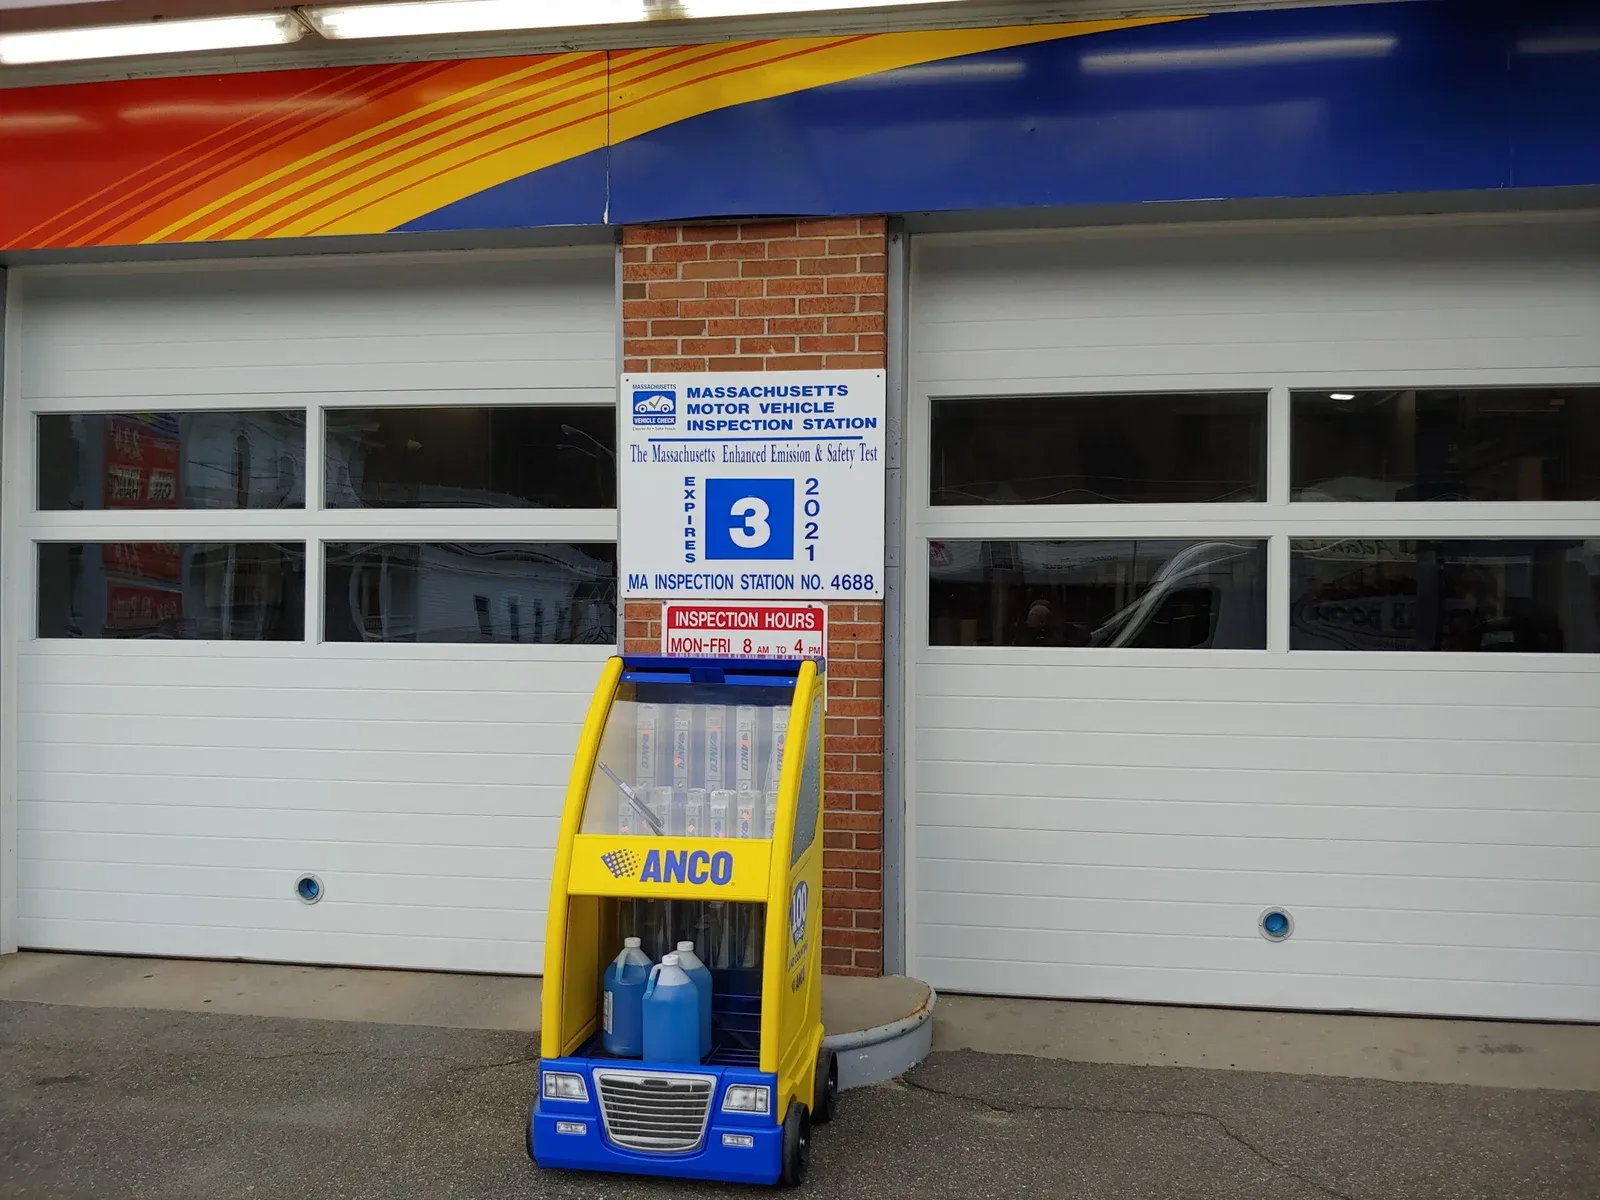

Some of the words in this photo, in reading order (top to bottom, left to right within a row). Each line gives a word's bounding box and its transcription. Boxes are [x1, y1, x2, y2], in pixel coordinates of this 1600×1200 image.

[687, 385, 849, 398] MASSACHUSETTS
[687, 403, 750, 415] MOTOR
[759, 402, 835, 414] VEHICLE
[687, 419, 793, 431] INSPECTION
[802, 417, 877, 430] STATION
[630, 445, 648, 462] The
[652, 444, 716, 463] Massachusetts
[722, 444, 767, 463] Enhanced
[770, 443, 811, 463] Emission
[814, 445, 823, 462] &
[826, 443, 856, 469] Safety
[859, 442, 878, 462] Test
[684, 476, 696, 563] EXPIRES
[728, 496, 771, 549] 3
[804, 478, 820, 561] 2021
[628, 574, 648, 590] MA
[655, 574, 734, 590] INSPECTION
[740, 574, 794, 590] STATION
[801, 574, 824, 590] NO.
[830, 574, 875, 590] 4688
[675, 611, 758, 628] INSPECTION
[765, 612, 815, 629] HOURS
[671, 637, 731, 653] MON-FRI
[743, 638, 752, 653] 8
[757, 645, 770, 654] AM
[776, 646, 787, 654] TO
[794, 639, 804, 654] 4
[808, 646, 821, 655] PM
[640, 849, 733, 885] ANCO
[791, 883, 807, 934] 100
